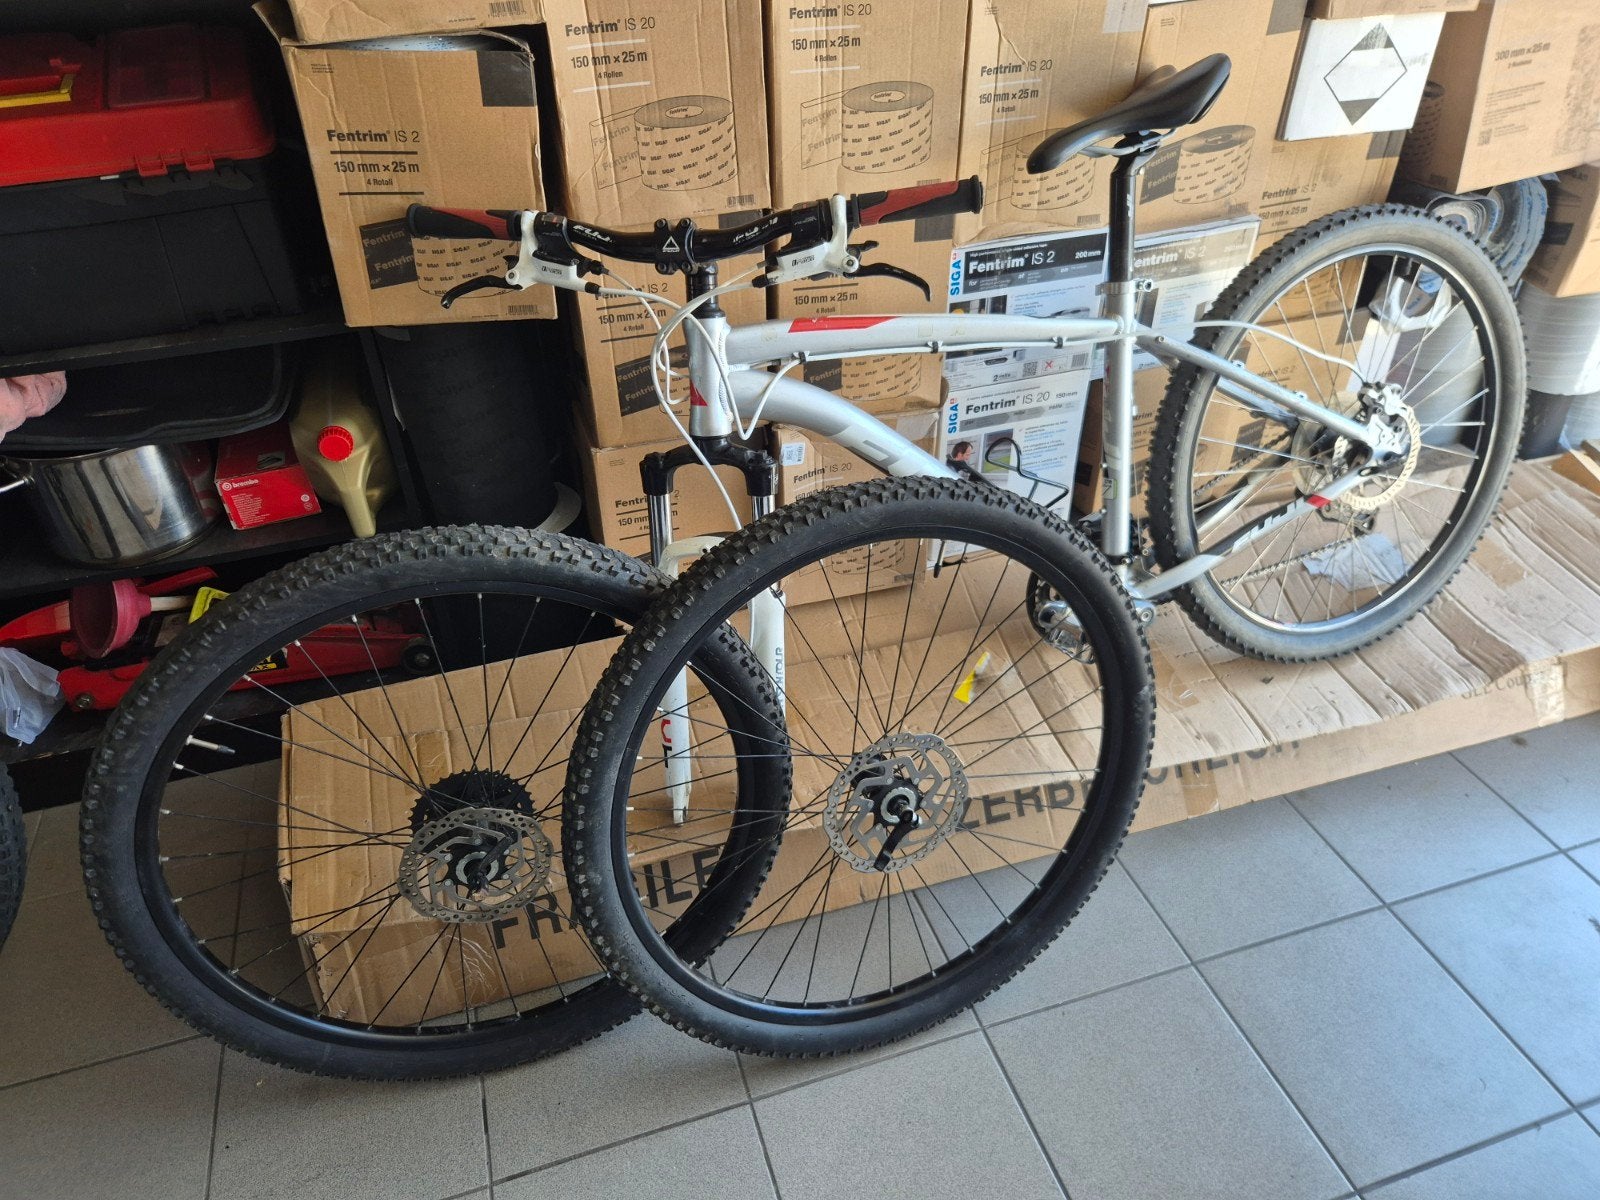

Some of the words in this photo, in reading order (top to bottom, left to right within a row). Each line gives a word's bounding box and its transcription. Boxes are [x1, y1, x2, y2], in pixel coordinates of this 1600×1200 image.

[843, 4, 855, 16] IS
[858, 4, 872, 15] 20
[625, 18, 636, 30] IS
[640, 17, 656, 30] 20
[791, 38, 808, 50] 150
[810, 39, 828, 49] mm
[838, 35, 850, 48] 25
[852, 37, 861, 46] m
[571, 55, 589, 69] 150
[592, 55, 611, 66] mm
[621, 50, 635, 63] 25
[637, 51, 648, 62] m
[1040, 59, 1053, 71] 20
[979, 92, 992, 105] 150
[993, 92, 1010, 103] mm
[1018, 88, 1029, 100] 25
[1030, 89, 1039, 98] m
[394, 130, 407, 142] IS
[411, 131, 420, 142] 2
[334, 161, 355, 173] 150
[357, 163, 380, 172] mm
[392, 161, 407, 172] 25
[408, 163, 420, 172] m
[1031, 252, 1043, 266] IS
[1046, 250, 1056, 263] 2
[1134, 251, 1179, 268] entrim
[950, 259, 961, 296] SIGA
[648, 283, 659, 294] IS
[661, 283, 668, 292] 2
[794, 295, 810, 305] 150
[811, 295, 828, 304] mm
[837, 292, 848, 302] 25
[599, 313, 615, 325] 150
[617, 313, 635, 322] mm
[657, 309, 666, 317] m
[1022, 393, 1033, 404] IS
[1036, 391, 1050, 403] 20
[948, 403, 959, 434] SIGA
[829, 464, 839, 473] IS
[841, 462, 852, 472] 20
[232, 479, 259, 488] brembo
[615, 495, 648, 508] Fentri
[673, 490, 680, 498] 2
[618, 517, 633, 526] 150
